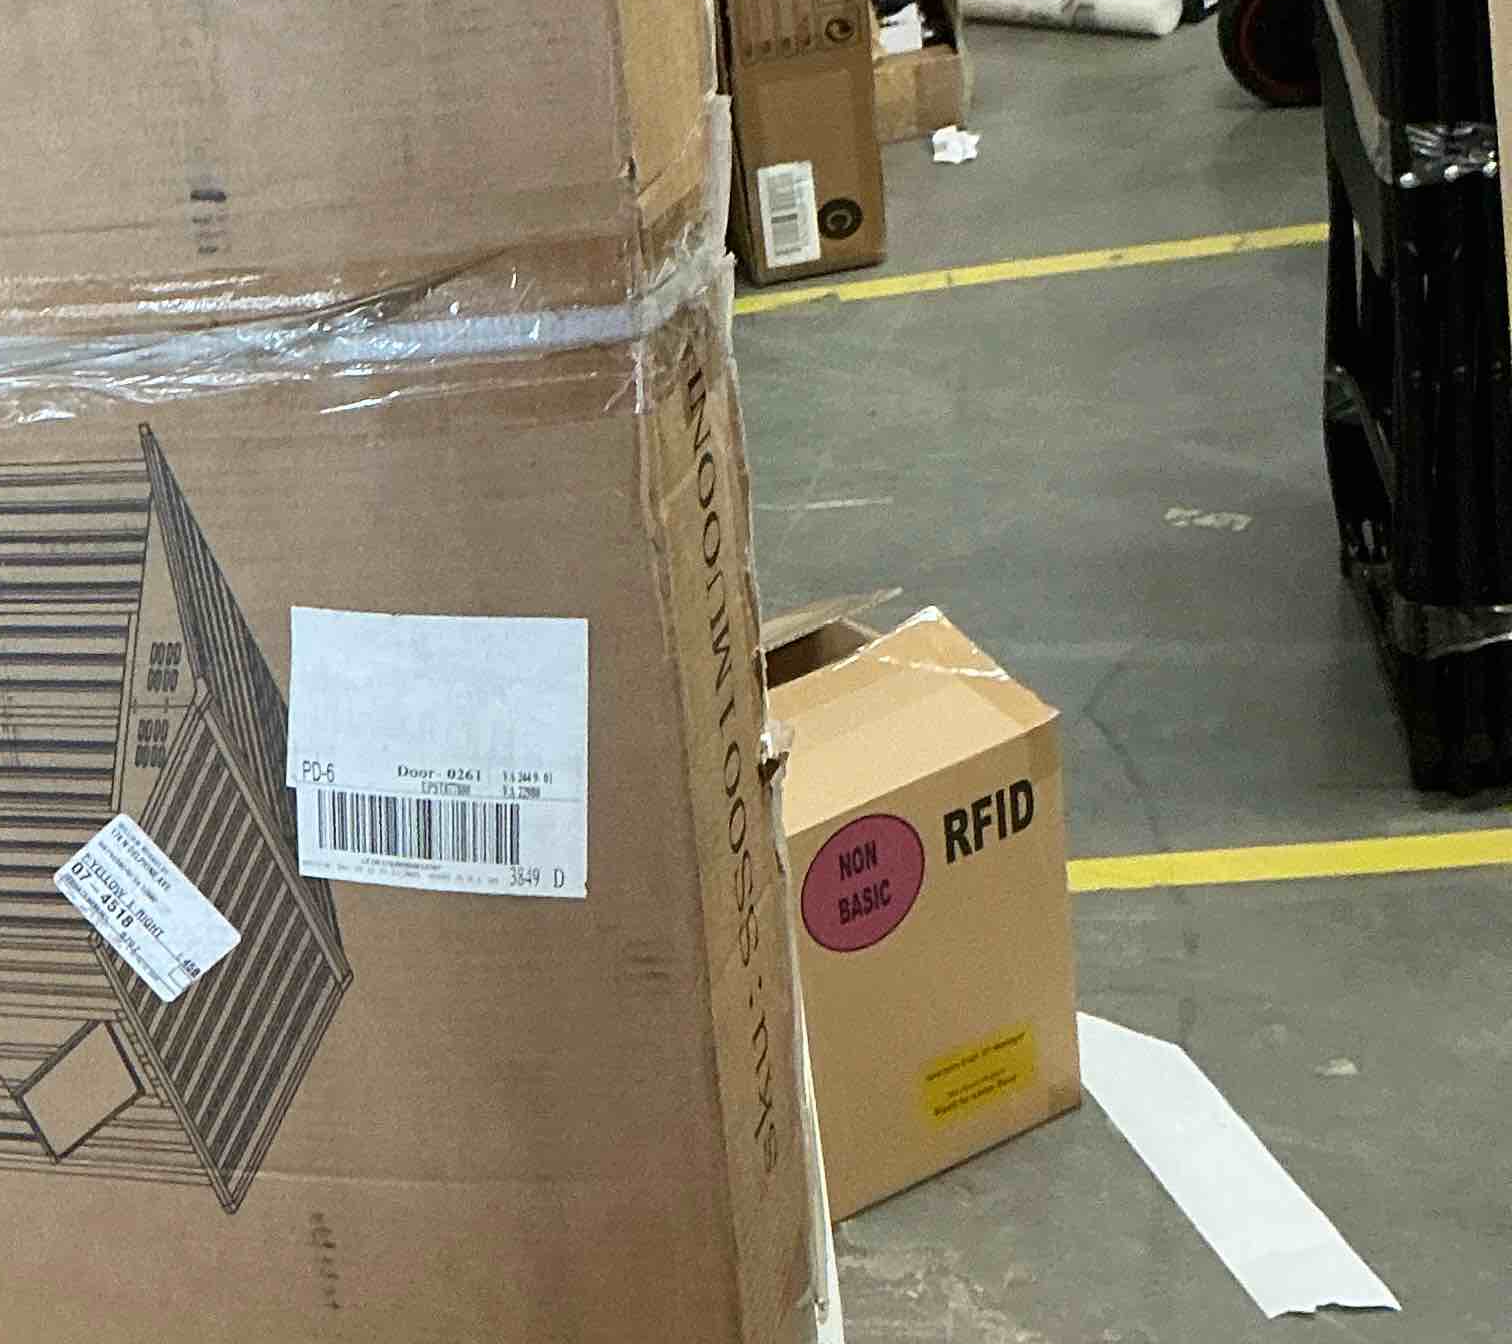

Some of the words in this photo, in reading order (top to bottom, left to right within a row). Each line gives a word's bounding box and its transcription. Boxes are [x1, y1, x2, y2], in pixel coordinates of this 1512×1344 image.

[302, 760, 335, 784] PD-6
[446, 765, 482, 782] 0261
[943, 778, 1035, 863] RFID
[509, 865, 541, 888] 3849
[553, 868, 565, 888] D
[838, 840, 878, 882] NON
[68, 860, 93, 884] 07
[96, 890, 136, 930] 4518
[838, 884, 892, 925] BASIC
